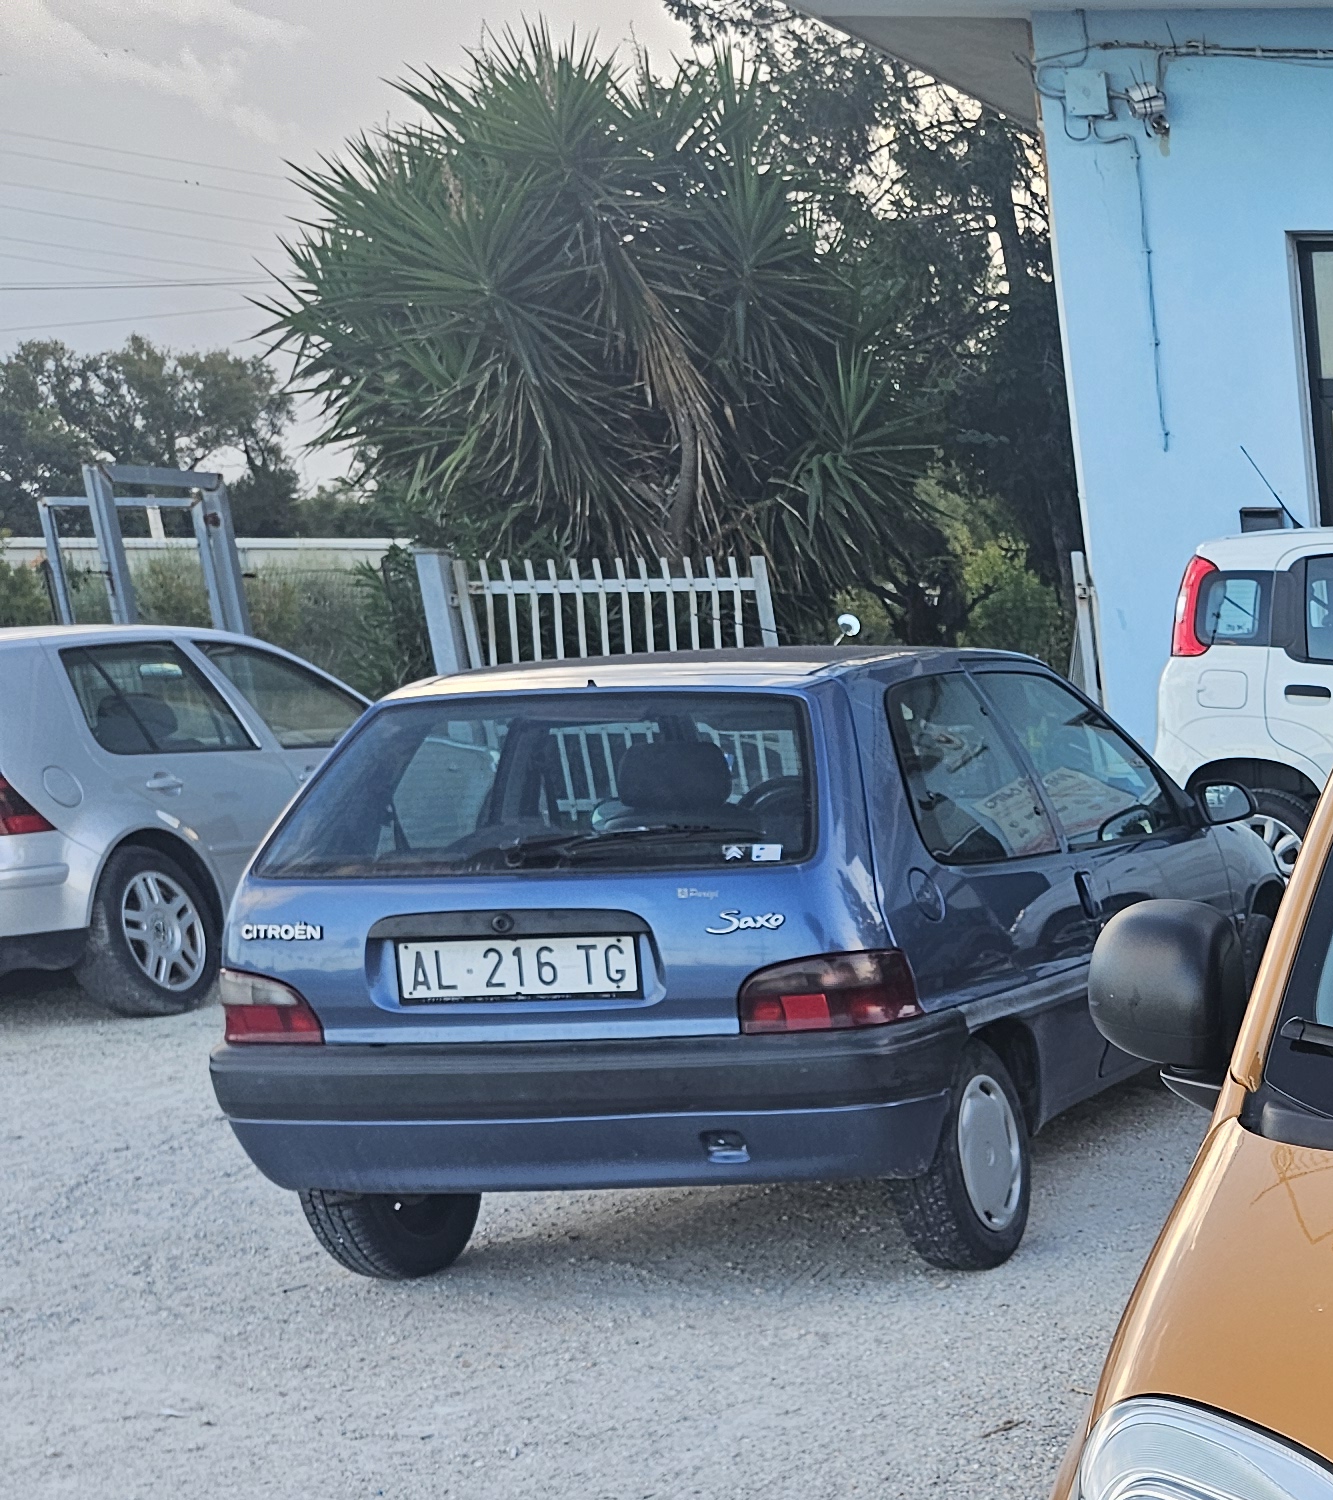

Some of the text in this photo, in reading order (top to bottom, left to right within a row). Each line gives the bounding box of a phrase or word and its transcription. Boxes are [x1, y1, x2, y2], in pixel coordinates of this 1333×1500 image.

[241, 921, 323, 941] CITROËN
[705, 909, 785, 934] Saxo
[412, 944, 627, 991] AL 216 TG
